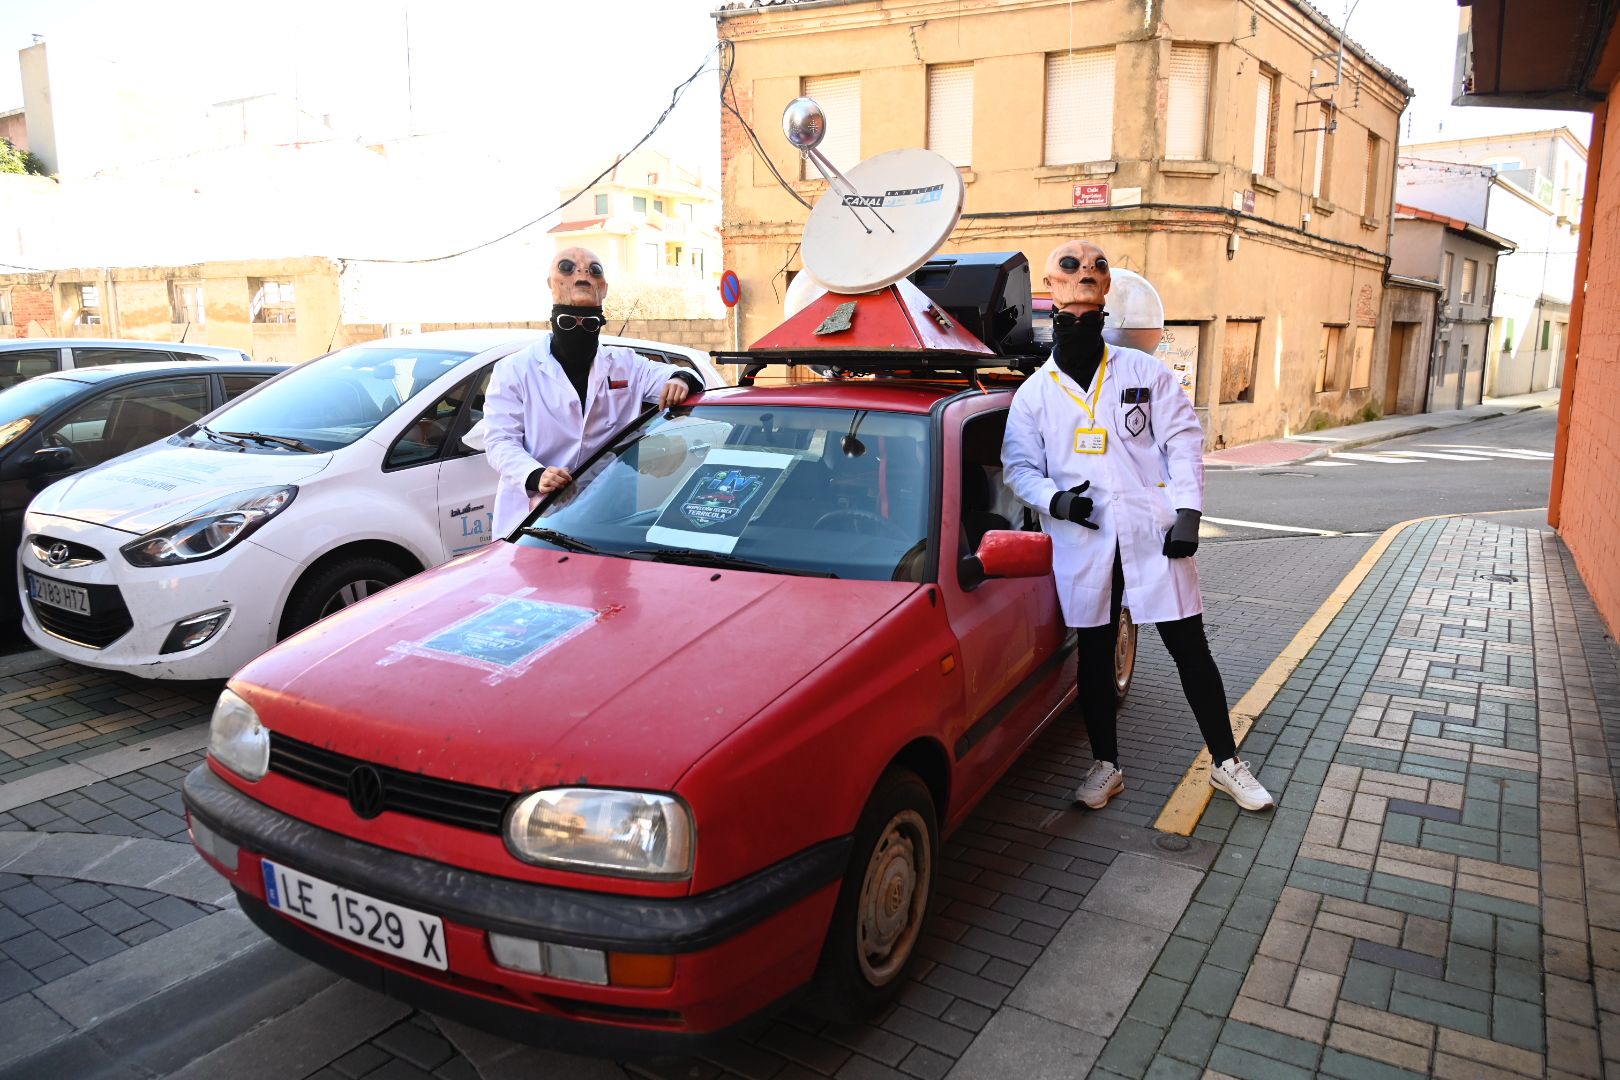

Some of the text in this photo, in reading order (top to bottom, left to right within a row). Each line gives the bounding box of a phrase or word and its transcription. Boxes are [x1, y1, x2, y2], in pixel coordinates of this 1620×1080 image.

[845, 197, 882, 206] CANAL
[461, 516, 483, 537] La
[36, 580, 87, 612] 2183 HTZ
[281, 873, 442, 962] LE 1529 X
